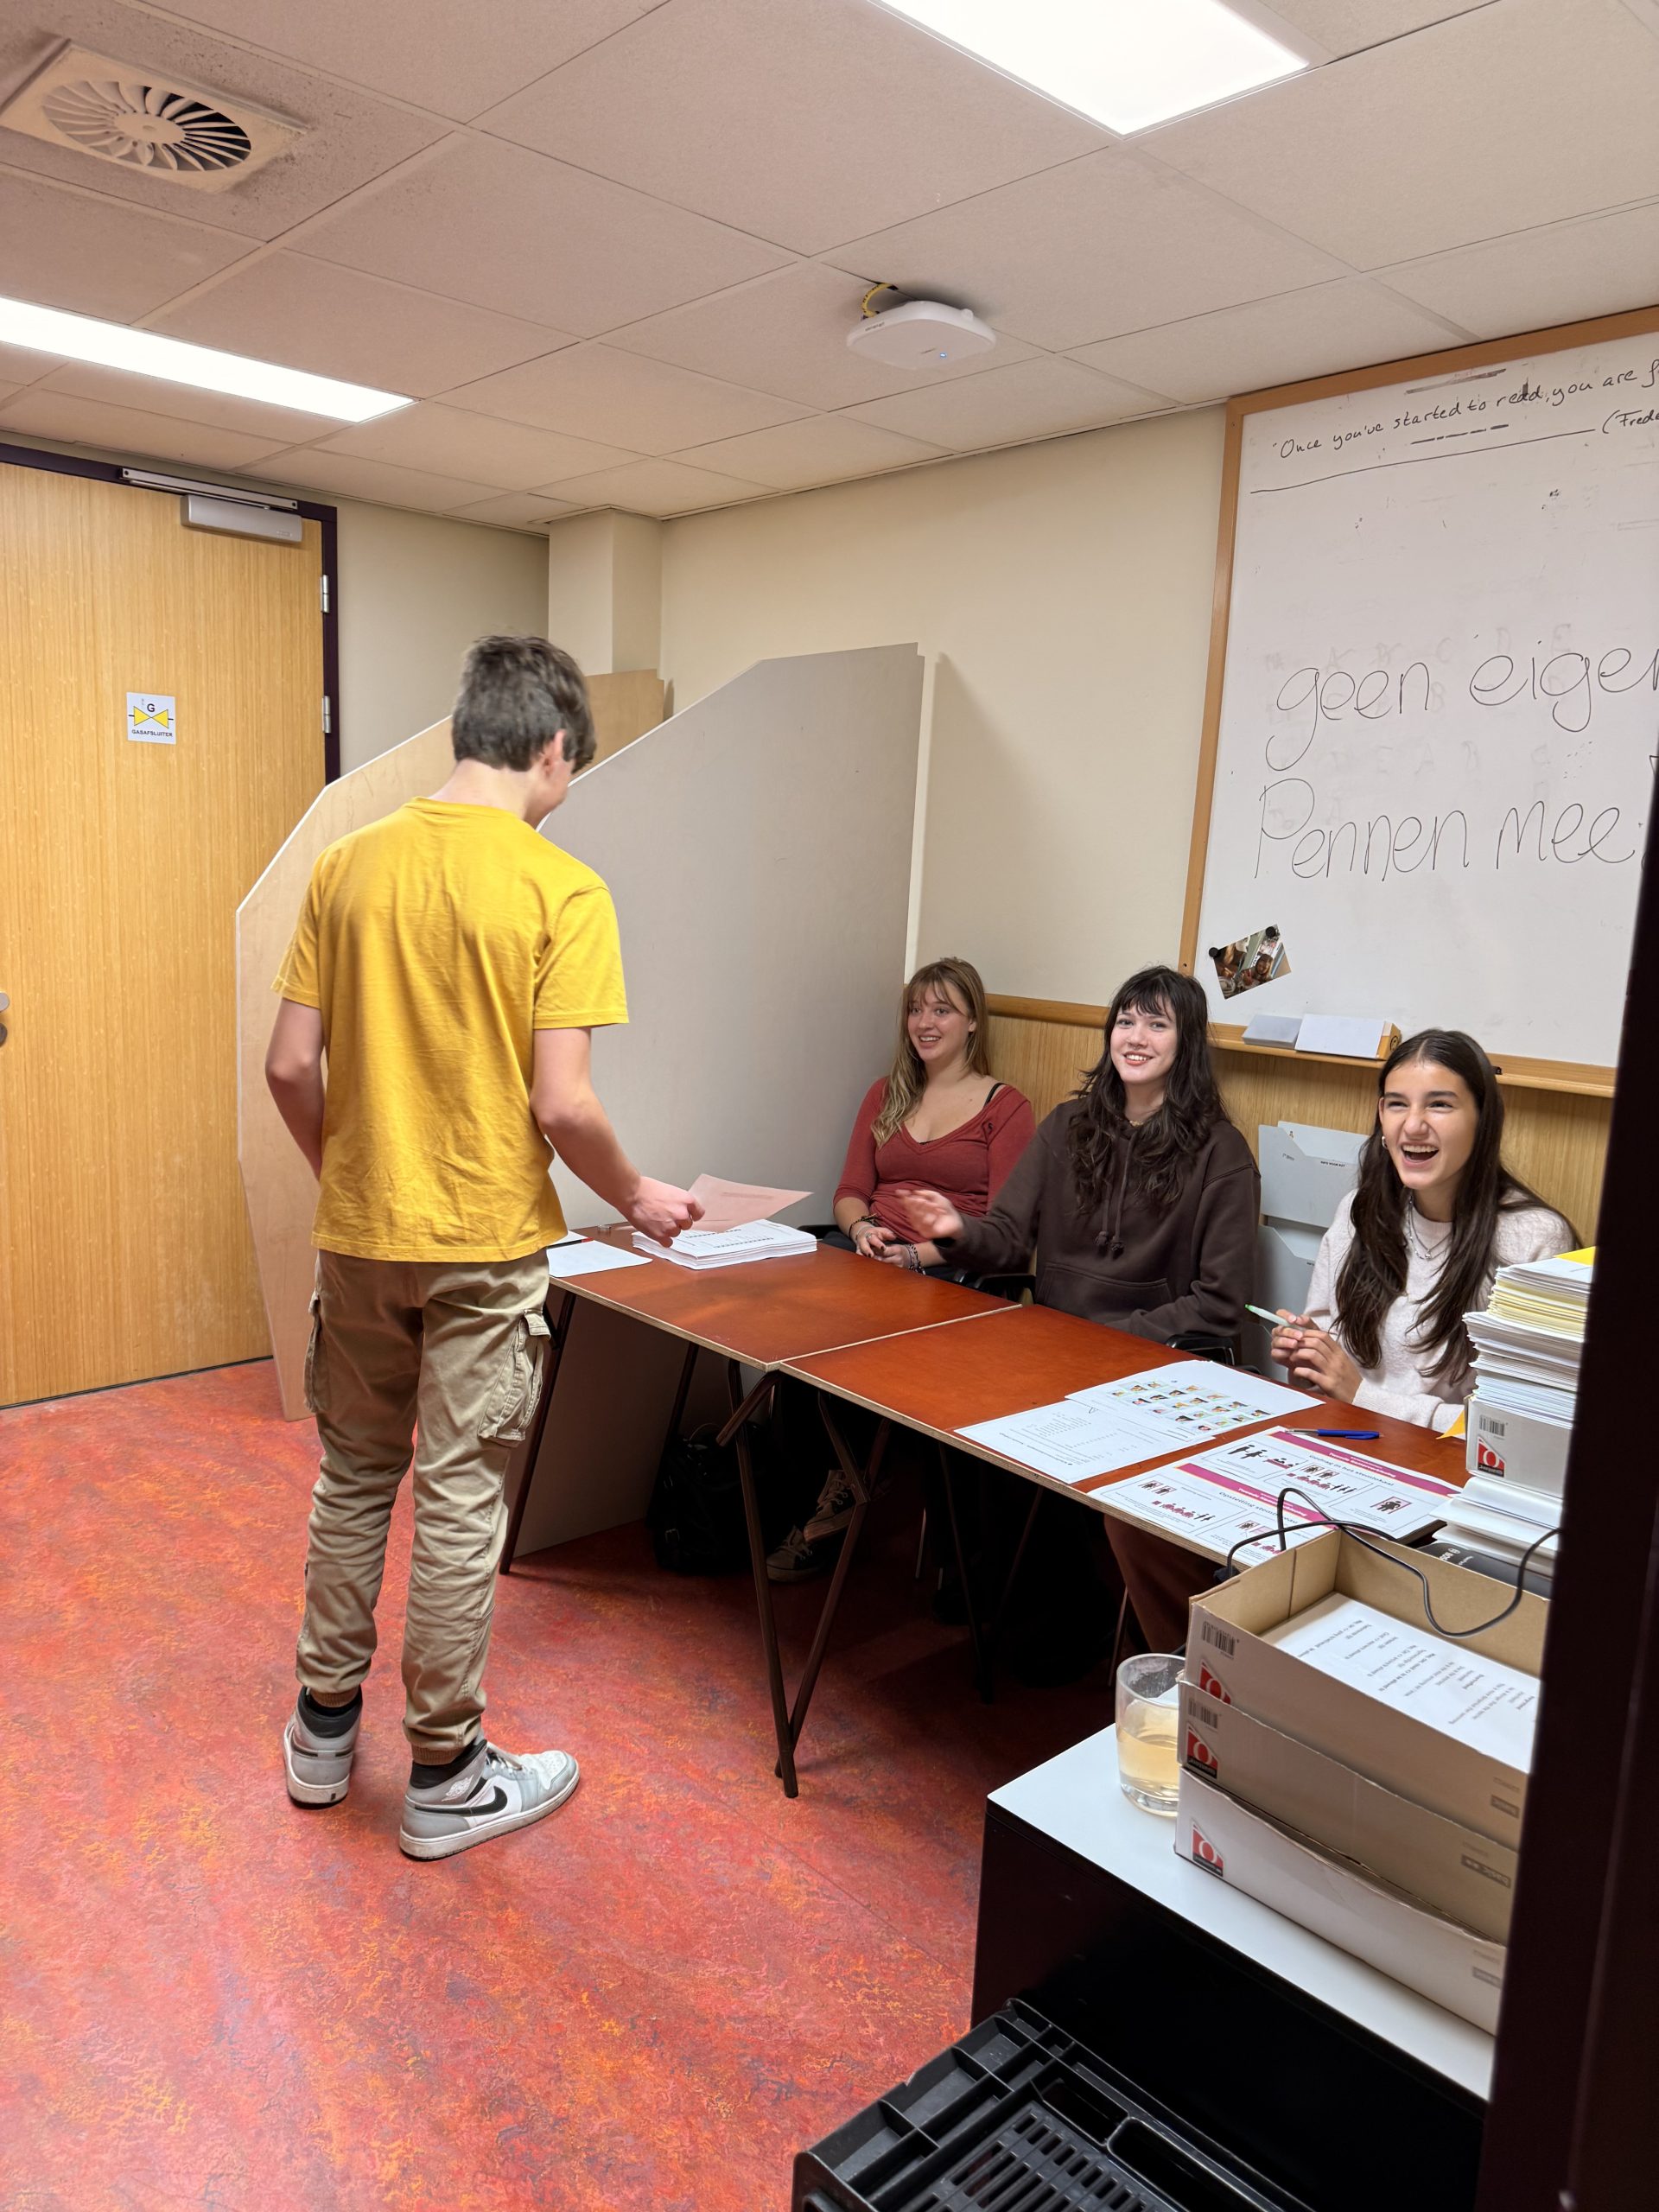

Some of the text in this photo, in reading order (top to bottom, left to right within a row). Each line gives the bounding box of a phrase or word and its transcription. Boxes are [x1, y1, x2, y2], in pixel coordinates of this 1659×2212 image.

[1333, 423, 1384, 450] you've
[1393, 400, 1462, 429] started
[1467, 397, 1486, 411] to
[1551, 384, 1593, 406] you
[1602, 369, 1638, 387] are
[1641, 359, 1659, 388] f
[147, 703, 156, 712] G
[1265, 661, 1430, 772] geen
[1255, 779, 1469, 881] Pennen
